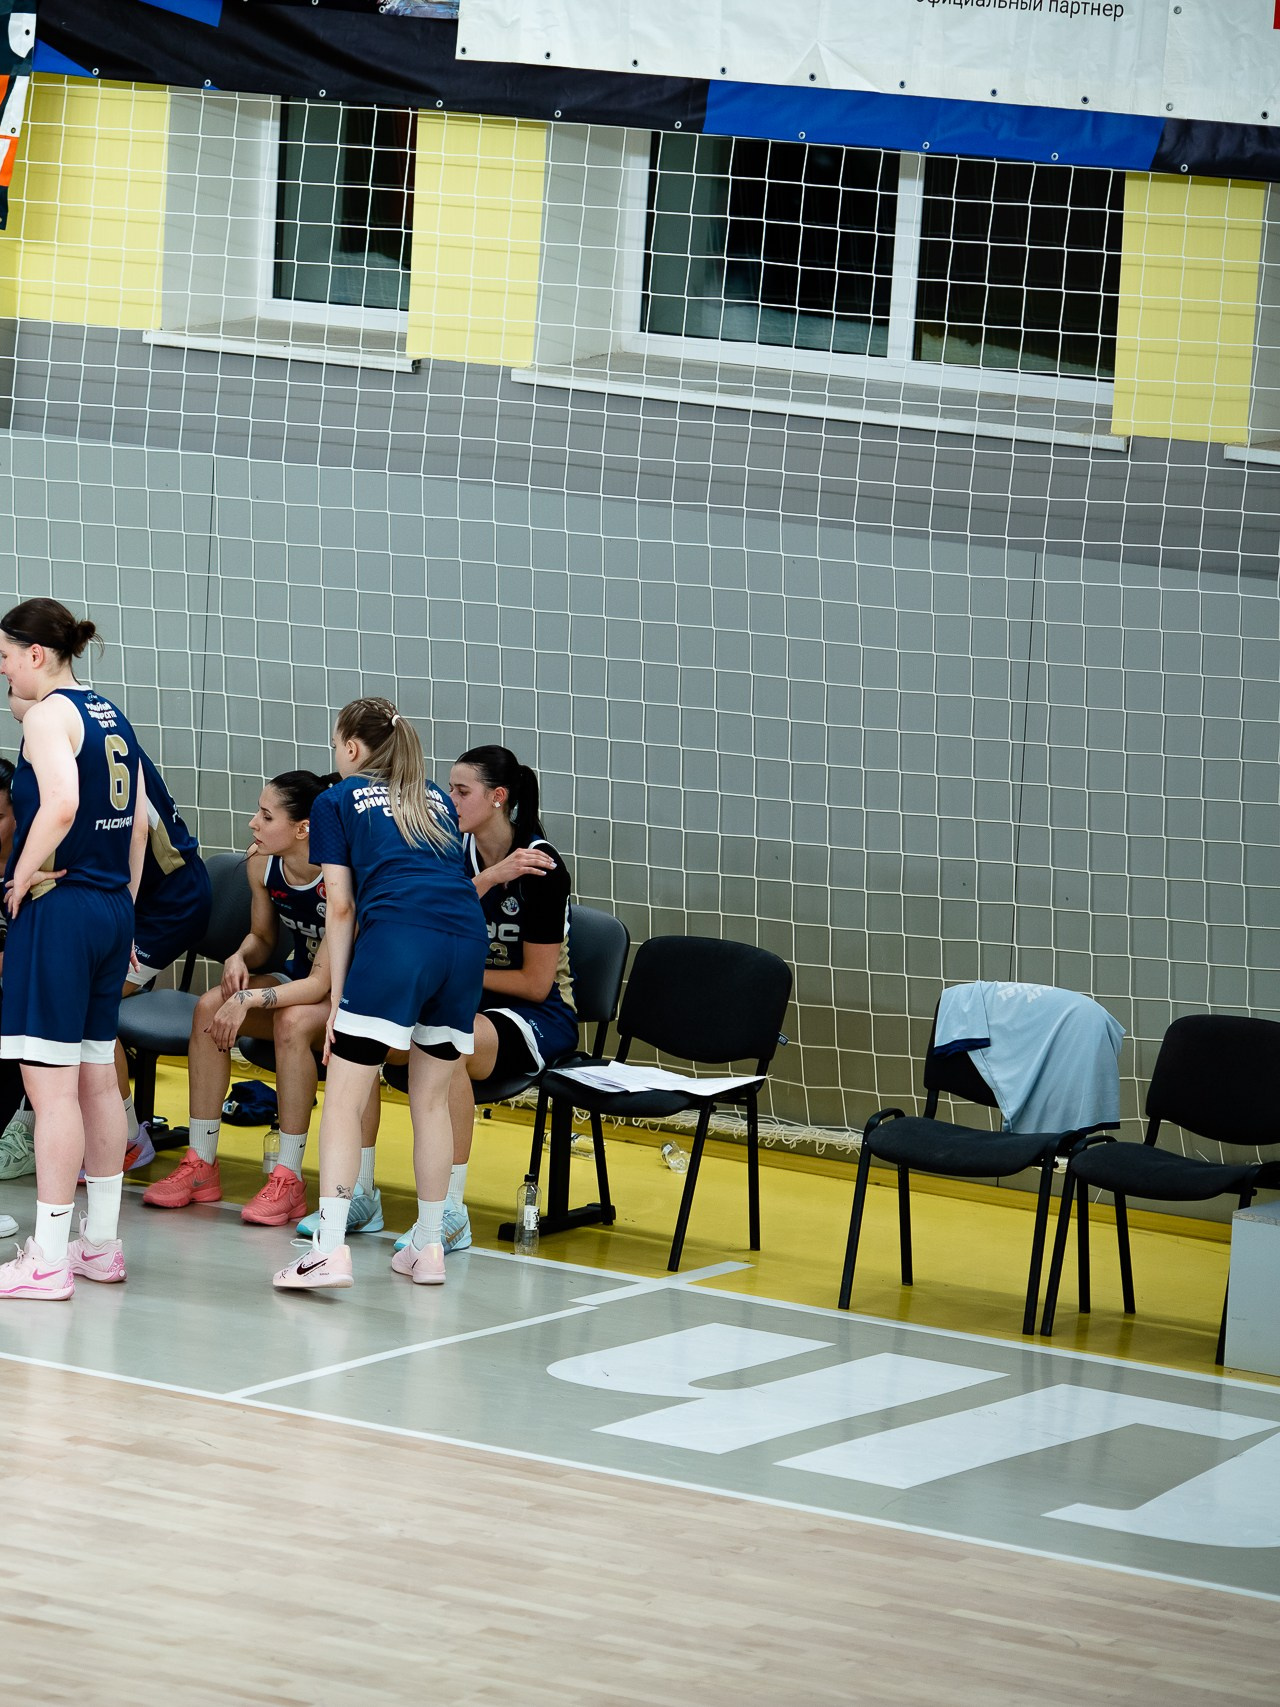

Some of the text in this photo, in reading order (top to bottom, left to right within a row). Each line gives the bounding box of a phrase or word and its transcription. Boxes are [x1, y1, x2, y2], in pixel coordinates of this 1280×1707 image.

[916, 0, 1125, 22] циальный партнер
[105, 734, 130, 811] 6
[486, 921, 520, 942] УС
